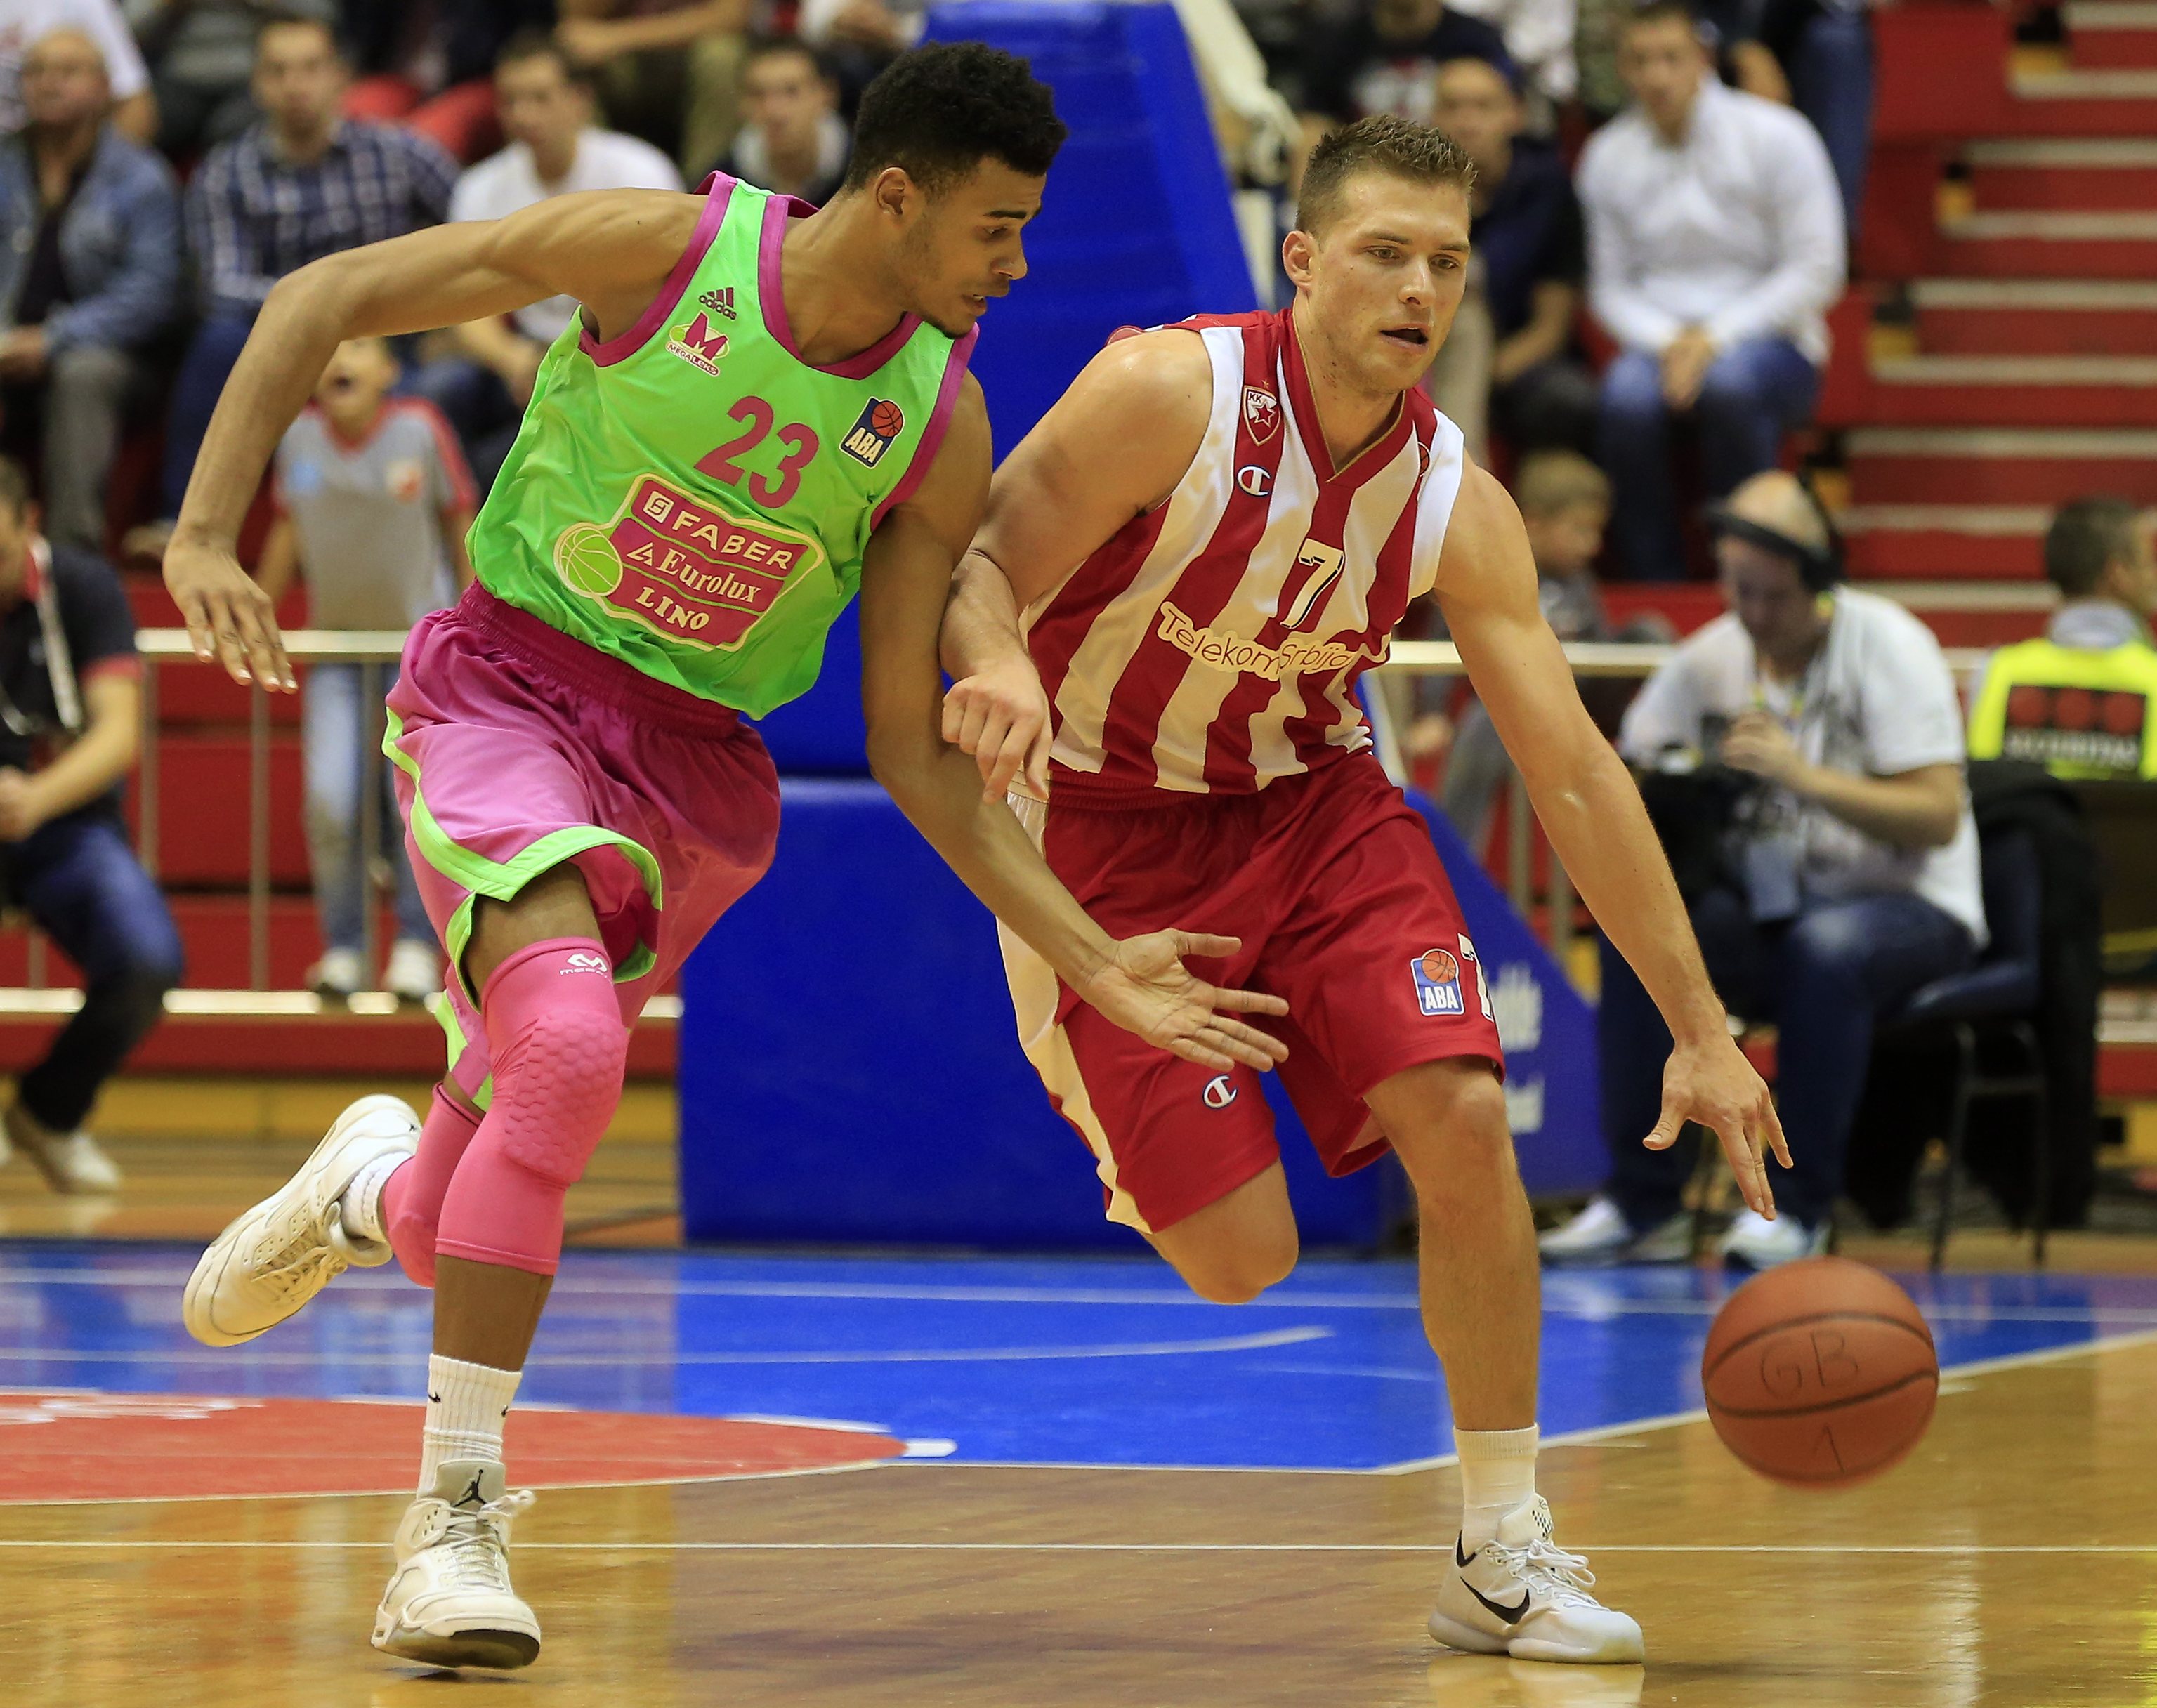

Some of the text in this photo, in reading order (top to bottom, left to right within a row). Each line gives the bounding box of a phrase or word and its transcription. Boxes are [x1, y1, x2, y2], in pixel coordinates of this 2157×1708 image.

[698, 295, 737, 320] adidas
[1248, 393, 1262, 404] KK
[694, 395, 820, 508] 23
[844, 426, 884, 464] ABA
[672, 509, 794, 570] FABER
[655, 546, 762, 604] Eurolux
[1280, 537, 1345, 629] 7
[634, 586, 710, 631] LINO
[1163, 606, 1353, 676] Telekom Srbija
[1424, 985, 1459, 1010] ABA
[1760, 1332, 1860, 1400] GB
